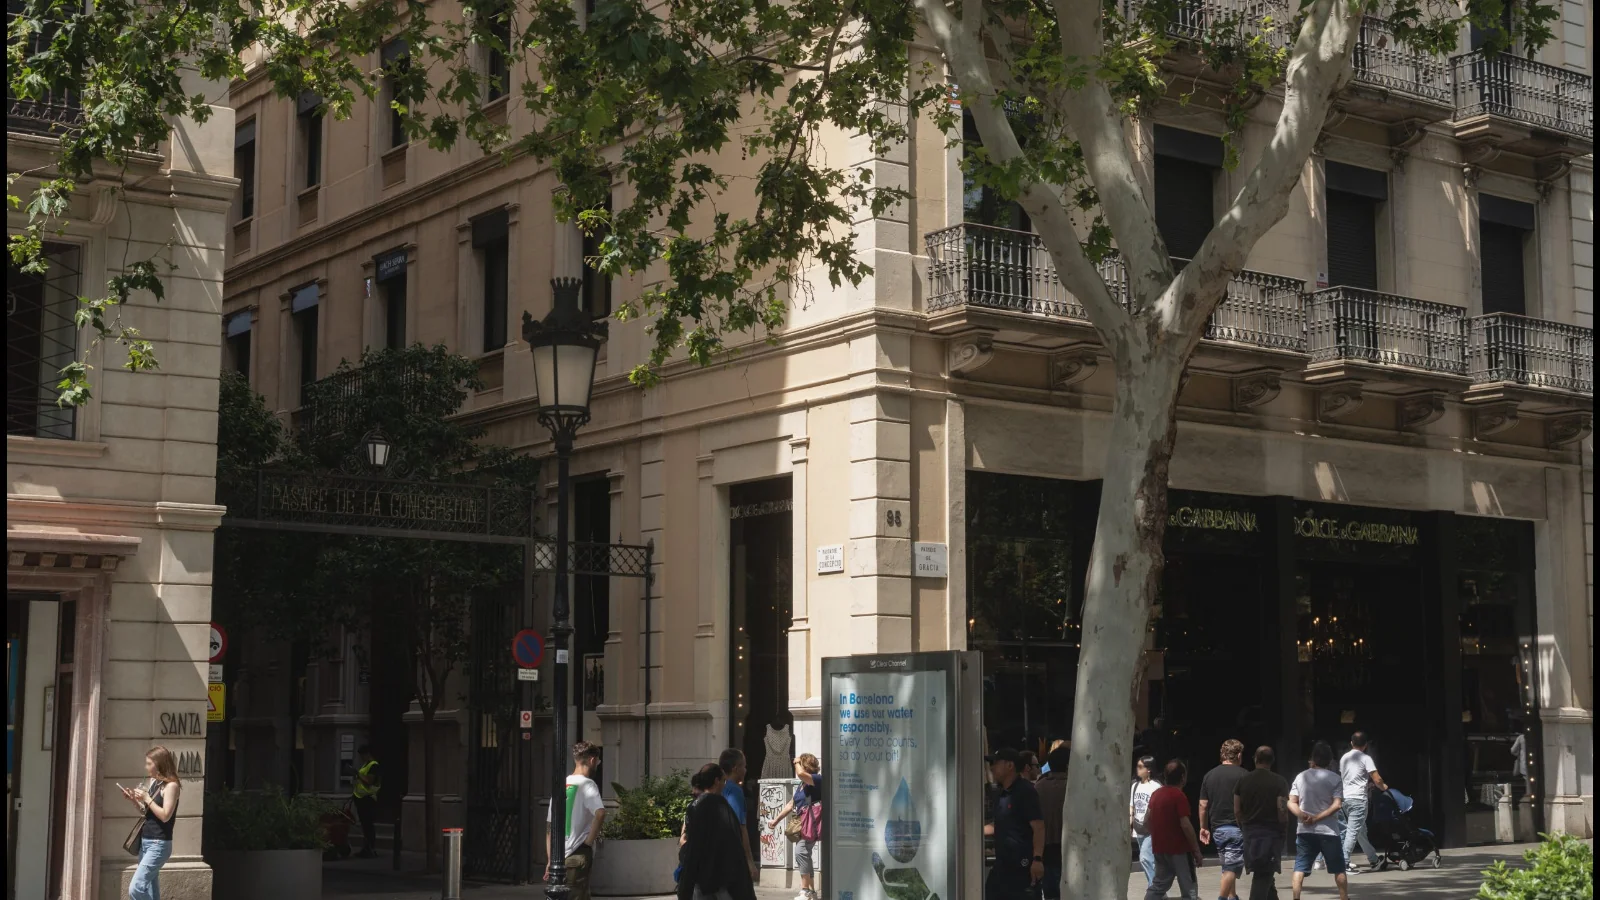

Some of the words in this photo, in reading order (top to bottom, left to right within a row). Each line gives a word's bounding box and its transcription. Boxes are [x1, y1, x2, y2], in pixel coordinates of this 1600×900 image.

[335, 489, 355, 514] DE
[363, 490, 381, 517] LA
[840, 693, 847, 704] In
[849, 693, 894, 704] Barcelona
[840, 710, 851, 718] we
[854, 710, 869, 719] use
[872, 711, 885, 719] our
[887, 707, 913, 719] water
[160, 712, 202, 735] SANTA
[840, 722, 892, 734] responsibly.
[840, 735, 860, 748] Every
[863, 735, 884, 748] drop
